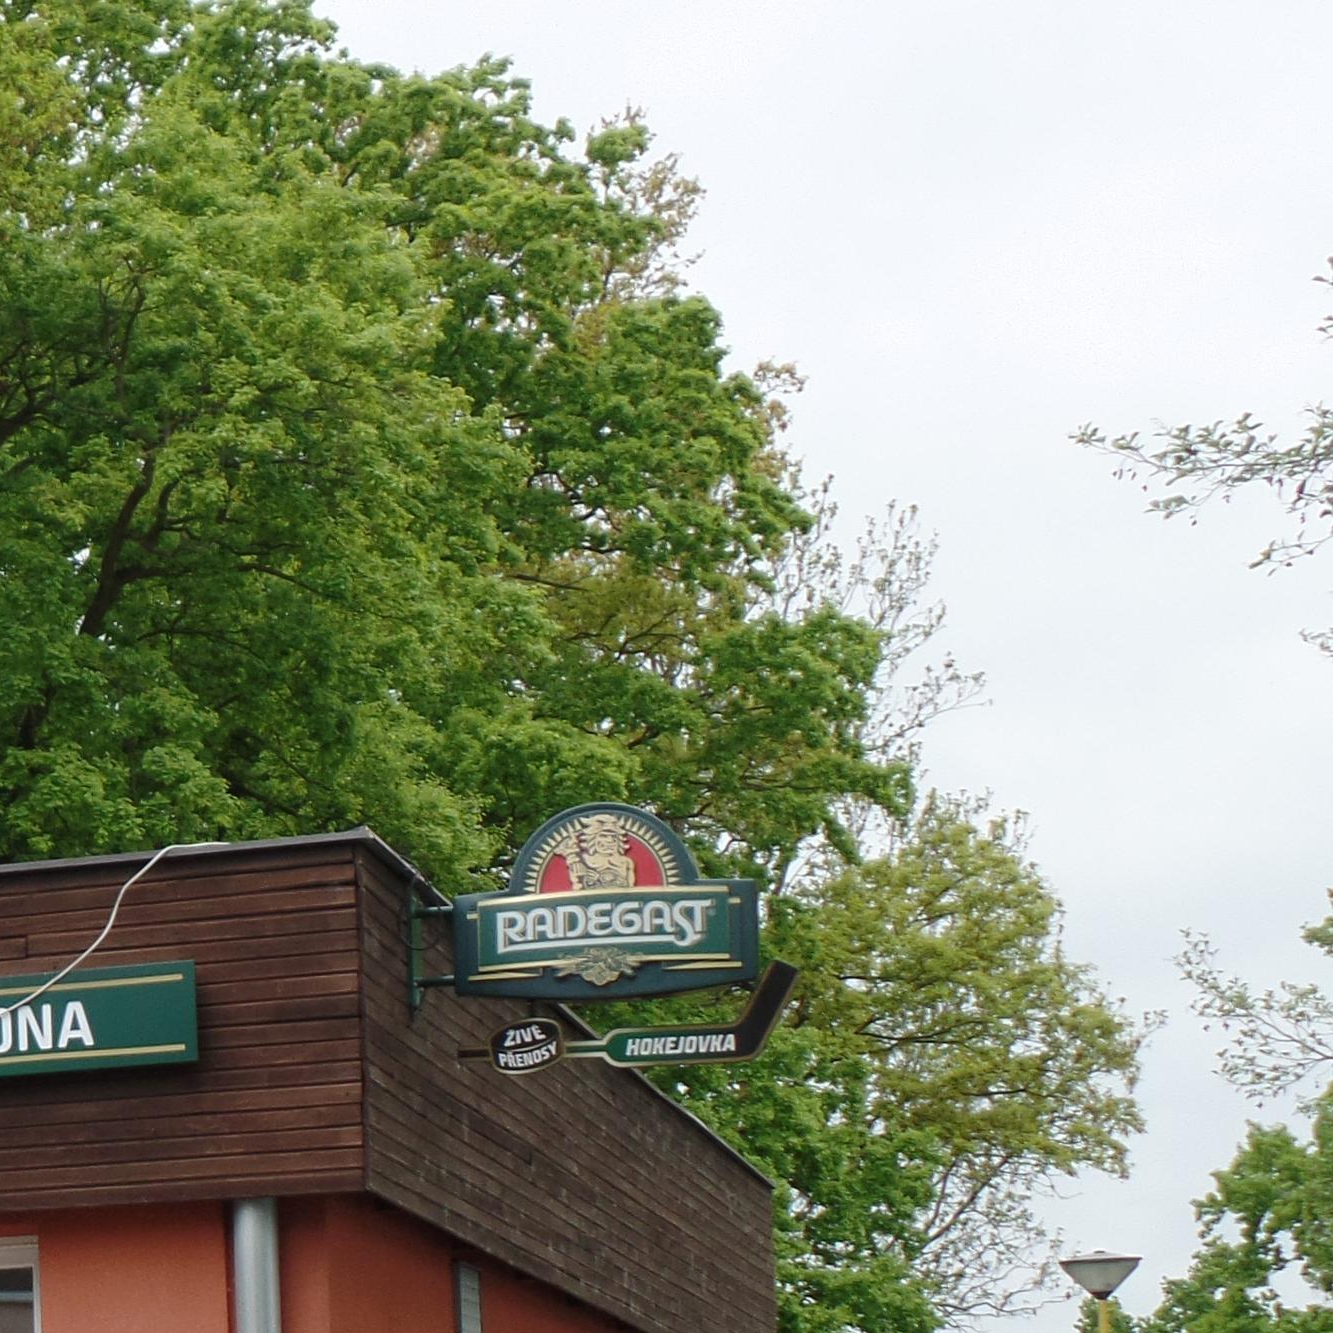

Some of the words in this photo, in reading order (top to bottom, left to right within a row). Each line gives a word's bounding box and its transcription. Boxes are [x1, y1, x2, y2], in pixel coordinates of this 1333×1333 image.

[497, 900, 713, 953] RADEGAST
[498, 1041, 557, 1068] PŘENOSY
[625, 1033, 736, 1056] HOKEJOVKA
